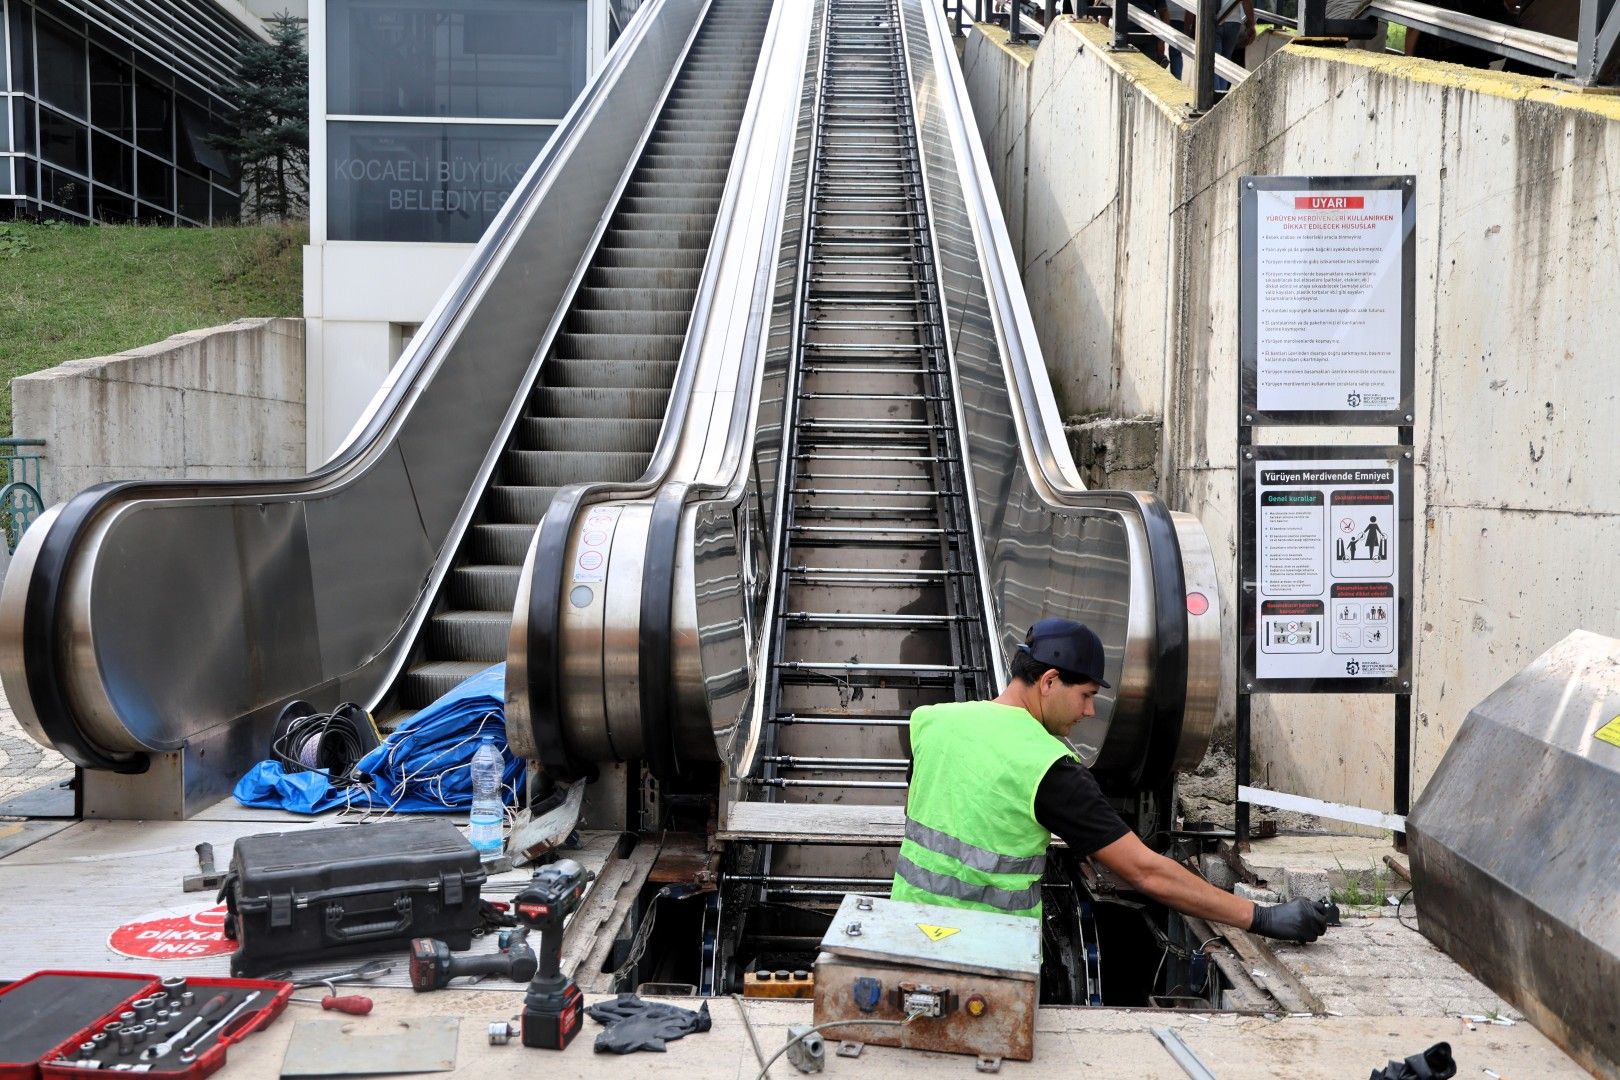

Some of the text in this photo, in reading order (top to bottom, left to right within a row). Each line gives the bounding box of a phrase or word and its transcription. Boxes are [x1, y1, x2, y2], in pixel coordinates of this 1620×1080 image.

[334, 156, 429, 182] KOCAELİ
[1312, 198, 1347, 208] UYARI
[1347, 214, 1394, 222] KULLANIRKEN
[1283, 222, 1307, 230] DİKKAT
[1264, 471, 1390, 483] Yürüyen Merdivende Emniyet
[136, 929, 234, 941] DİKKA
